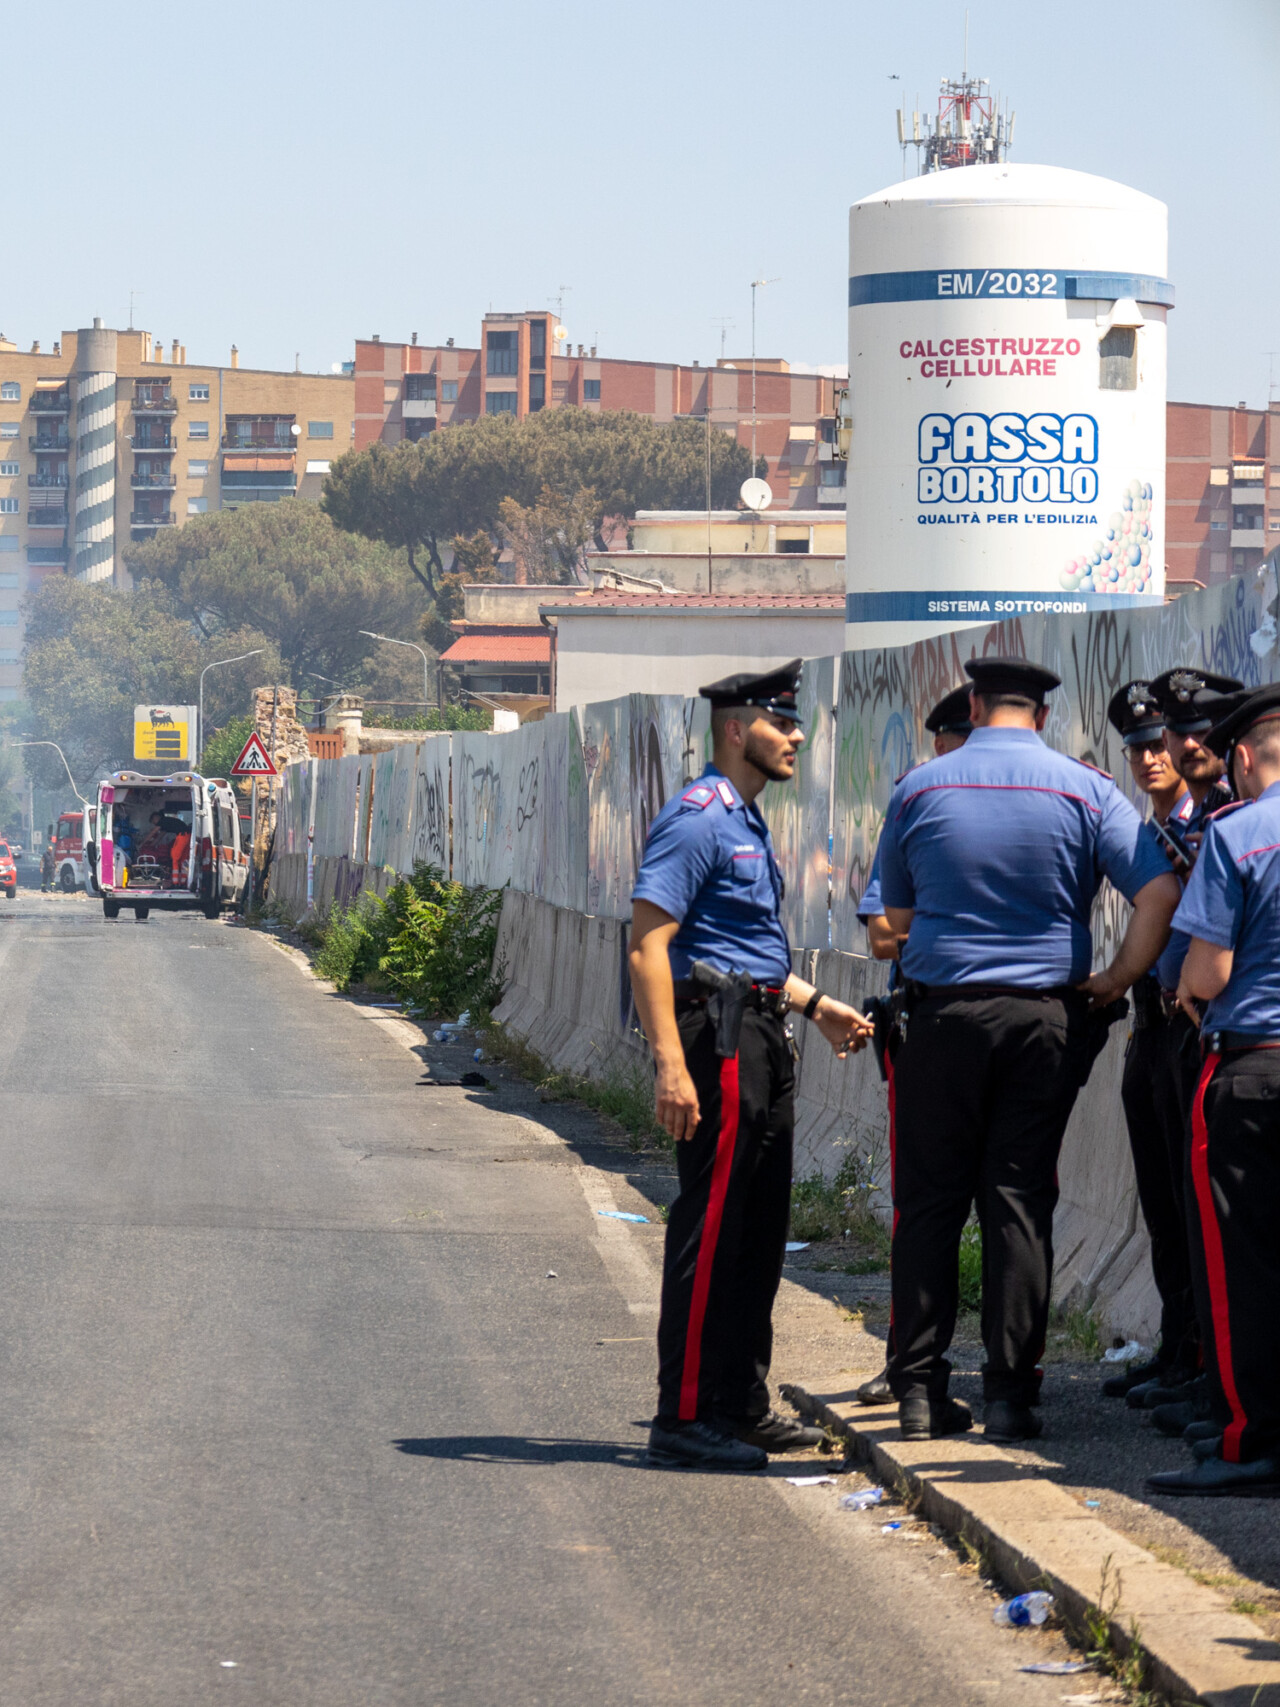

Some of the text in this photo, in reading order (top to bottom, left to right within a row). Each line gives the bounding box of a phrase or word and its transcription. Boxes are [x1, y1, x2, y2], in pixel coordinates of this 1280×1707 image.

[937, 271, 1057, 296] EM/2032
[899, 338, 1081, 358] CALCESTRUZZO
[920, 359, 1057, 378] CELLULARE
[918, 413, 1099, 463] FASSA
[918, 467, 1099, 503] BORTOLO
[917, 511, 1098, 525] QUALITÀ PER L'EDILIZIA
[927, 600, 1087, 614] SISTEMA SOTTOFONDI
